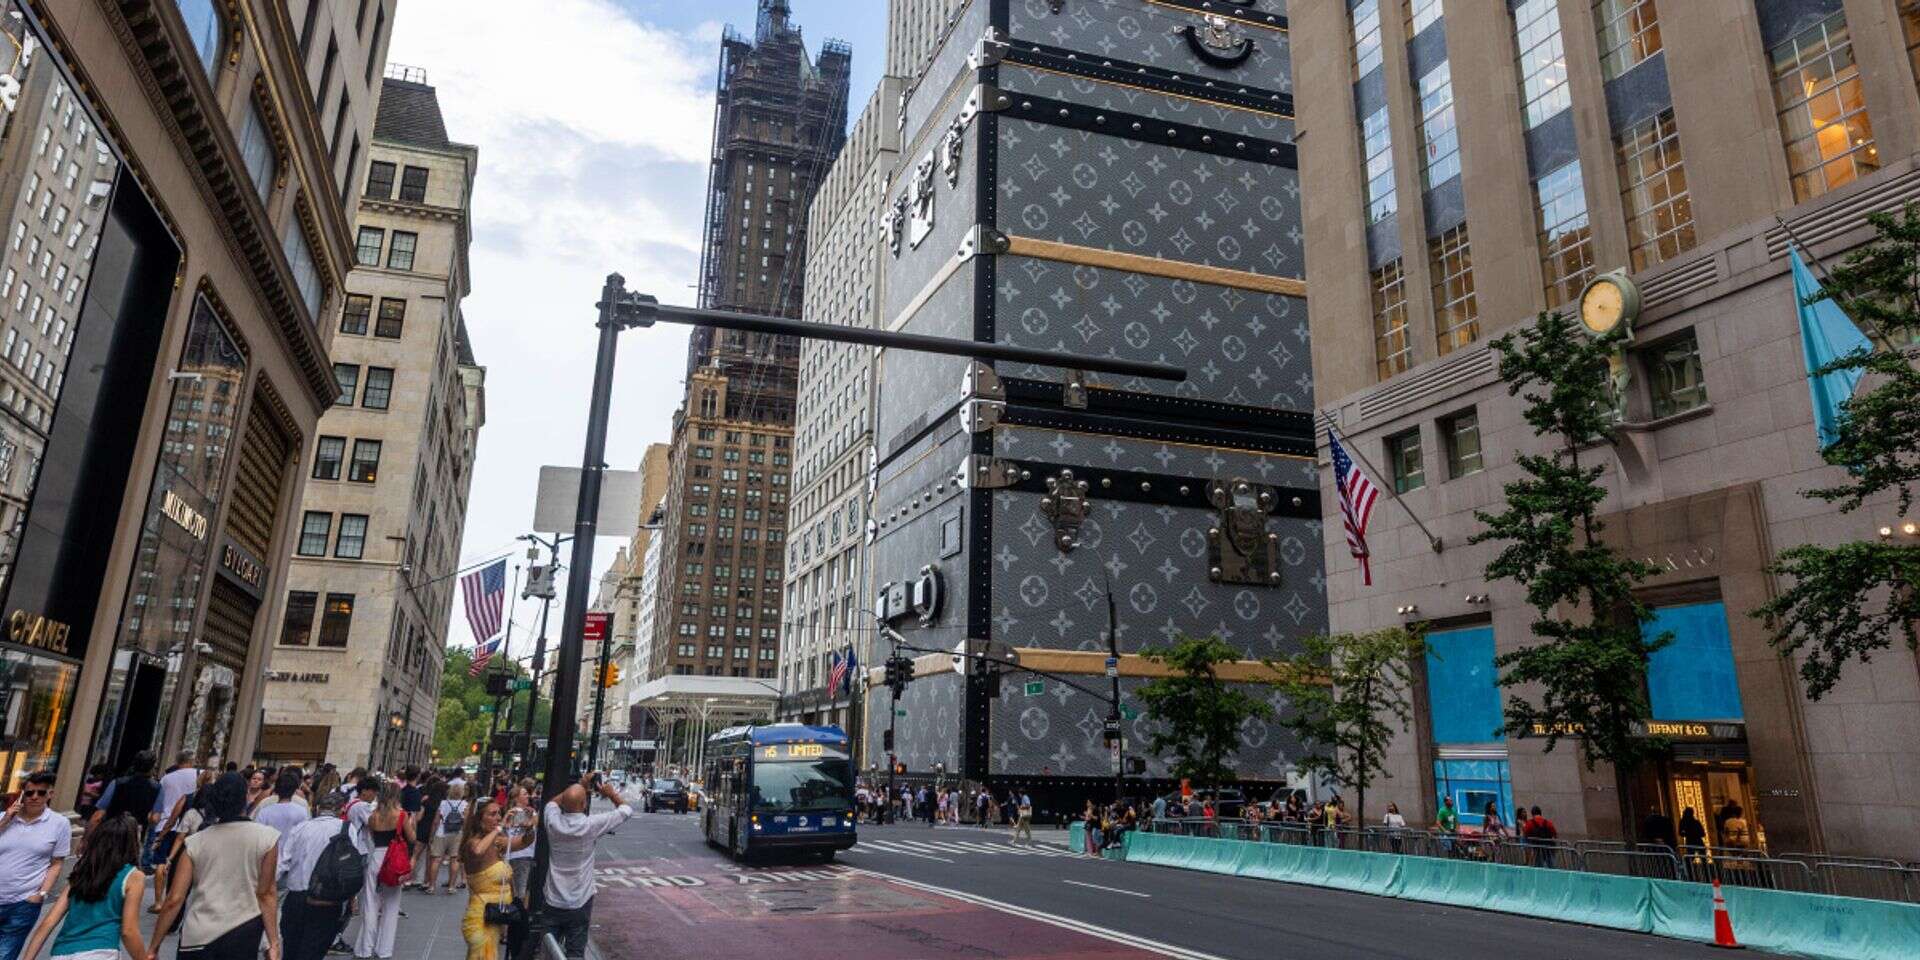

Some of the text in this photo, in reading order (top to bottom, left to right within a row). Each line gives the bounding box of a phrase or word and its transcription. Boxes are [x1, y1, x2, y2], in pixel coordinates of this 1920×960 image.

[160, 490, 207, 540] MIKIMOTO
[224, 545, 262, 589] BVLGARI
[10, 609, 71, 654] CHANEL
[299, 672, 329, 683] ARPELS
[1648, 723, 1683, 735] TIFFANY
[1685, 724, 1693, 736] &
[789, 744, 823, 757] LIMITED
